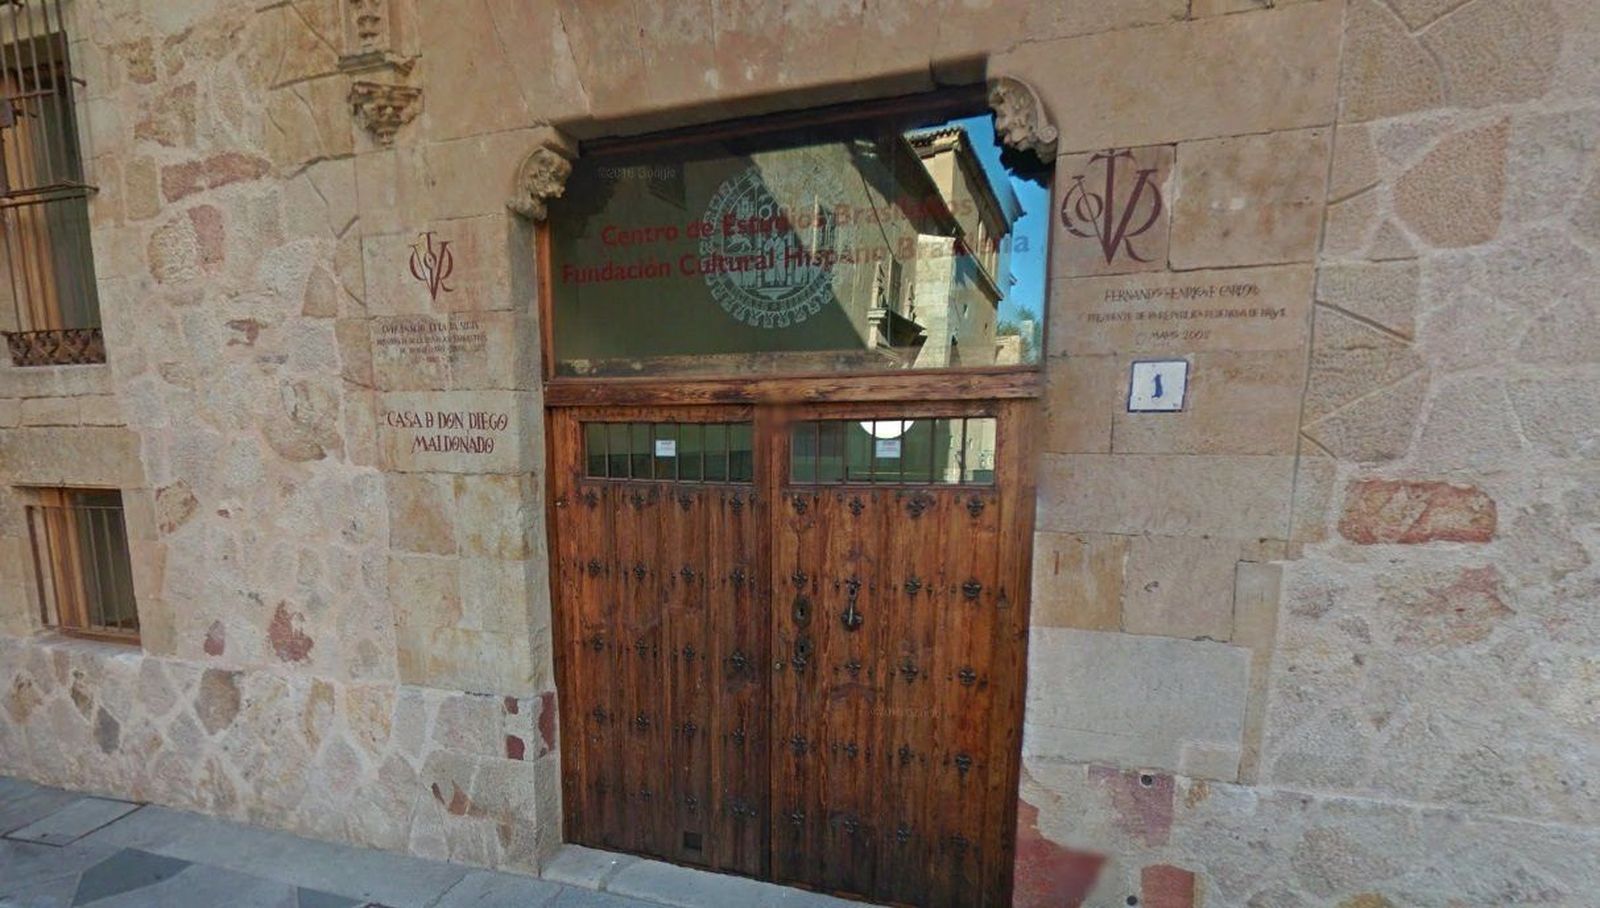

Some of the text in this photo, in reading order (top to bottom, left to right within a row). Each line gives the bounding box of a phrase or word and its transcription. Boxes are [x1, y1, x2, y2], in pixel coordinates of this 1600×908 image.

[600, 225, 677, 246] Centro
[686, 220, 717, 239] de
[561, 259, 670, 284] Fundación
[678, 248, 776, 276] Cultural
[1151, 373, 1164, 399] 1
[387, 410, 422, 428] CASA
[437, 411, 464, 430] DON
[467, 411, 508, 432] DIEGO
[411, 435, 495, 454] MALDONADO
